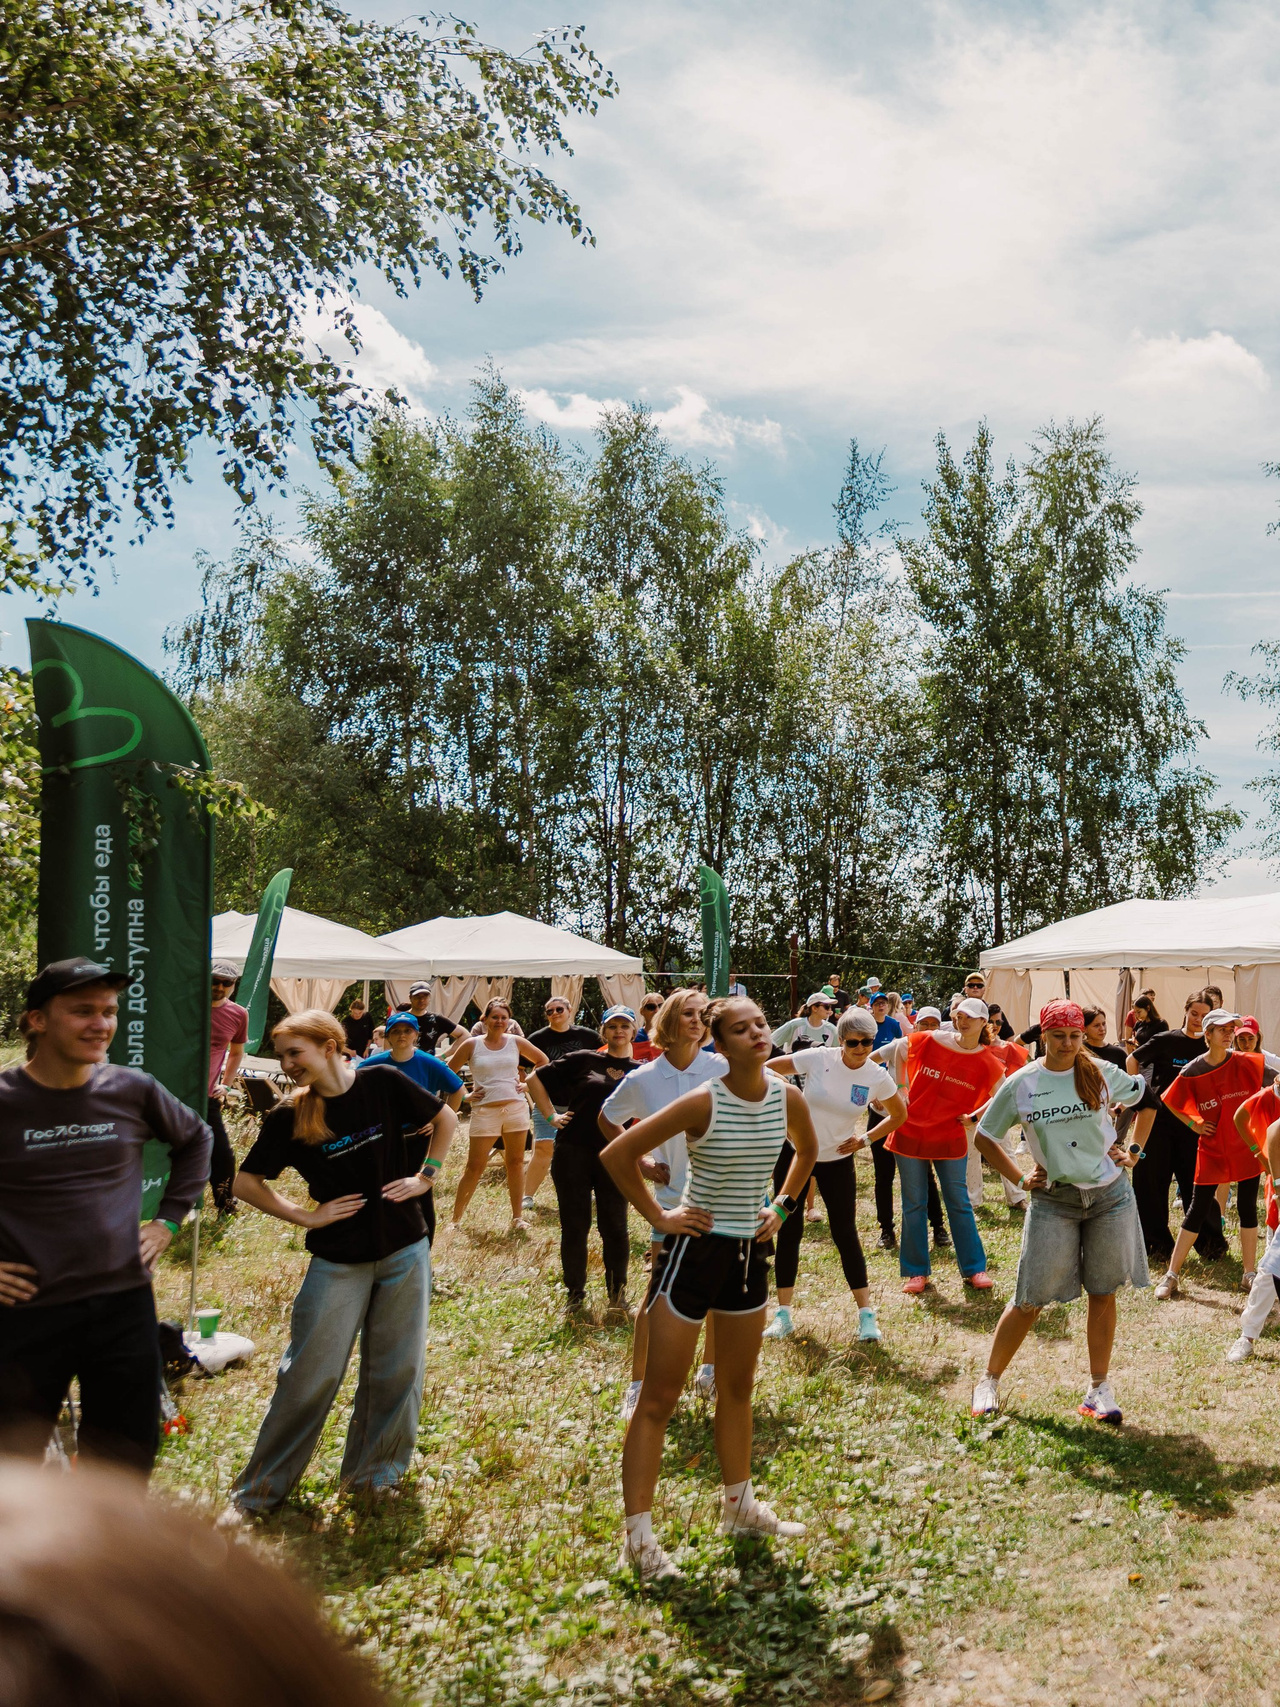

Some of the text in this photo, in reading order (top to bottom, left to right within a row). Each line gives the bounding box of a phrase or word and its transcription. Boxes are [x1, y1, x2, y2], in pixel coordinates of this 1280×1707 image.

[94, 824, 114, 868] еда
[89, 875, 111, 951] чтобы
[128, 898, 150, 1014] доступна
[128, 1020, 145, 1066] ыла
[922, 1066, 941, 1079] ПСБ
[1199, 1090, 1250, 1111] ПСБ олонтеры
